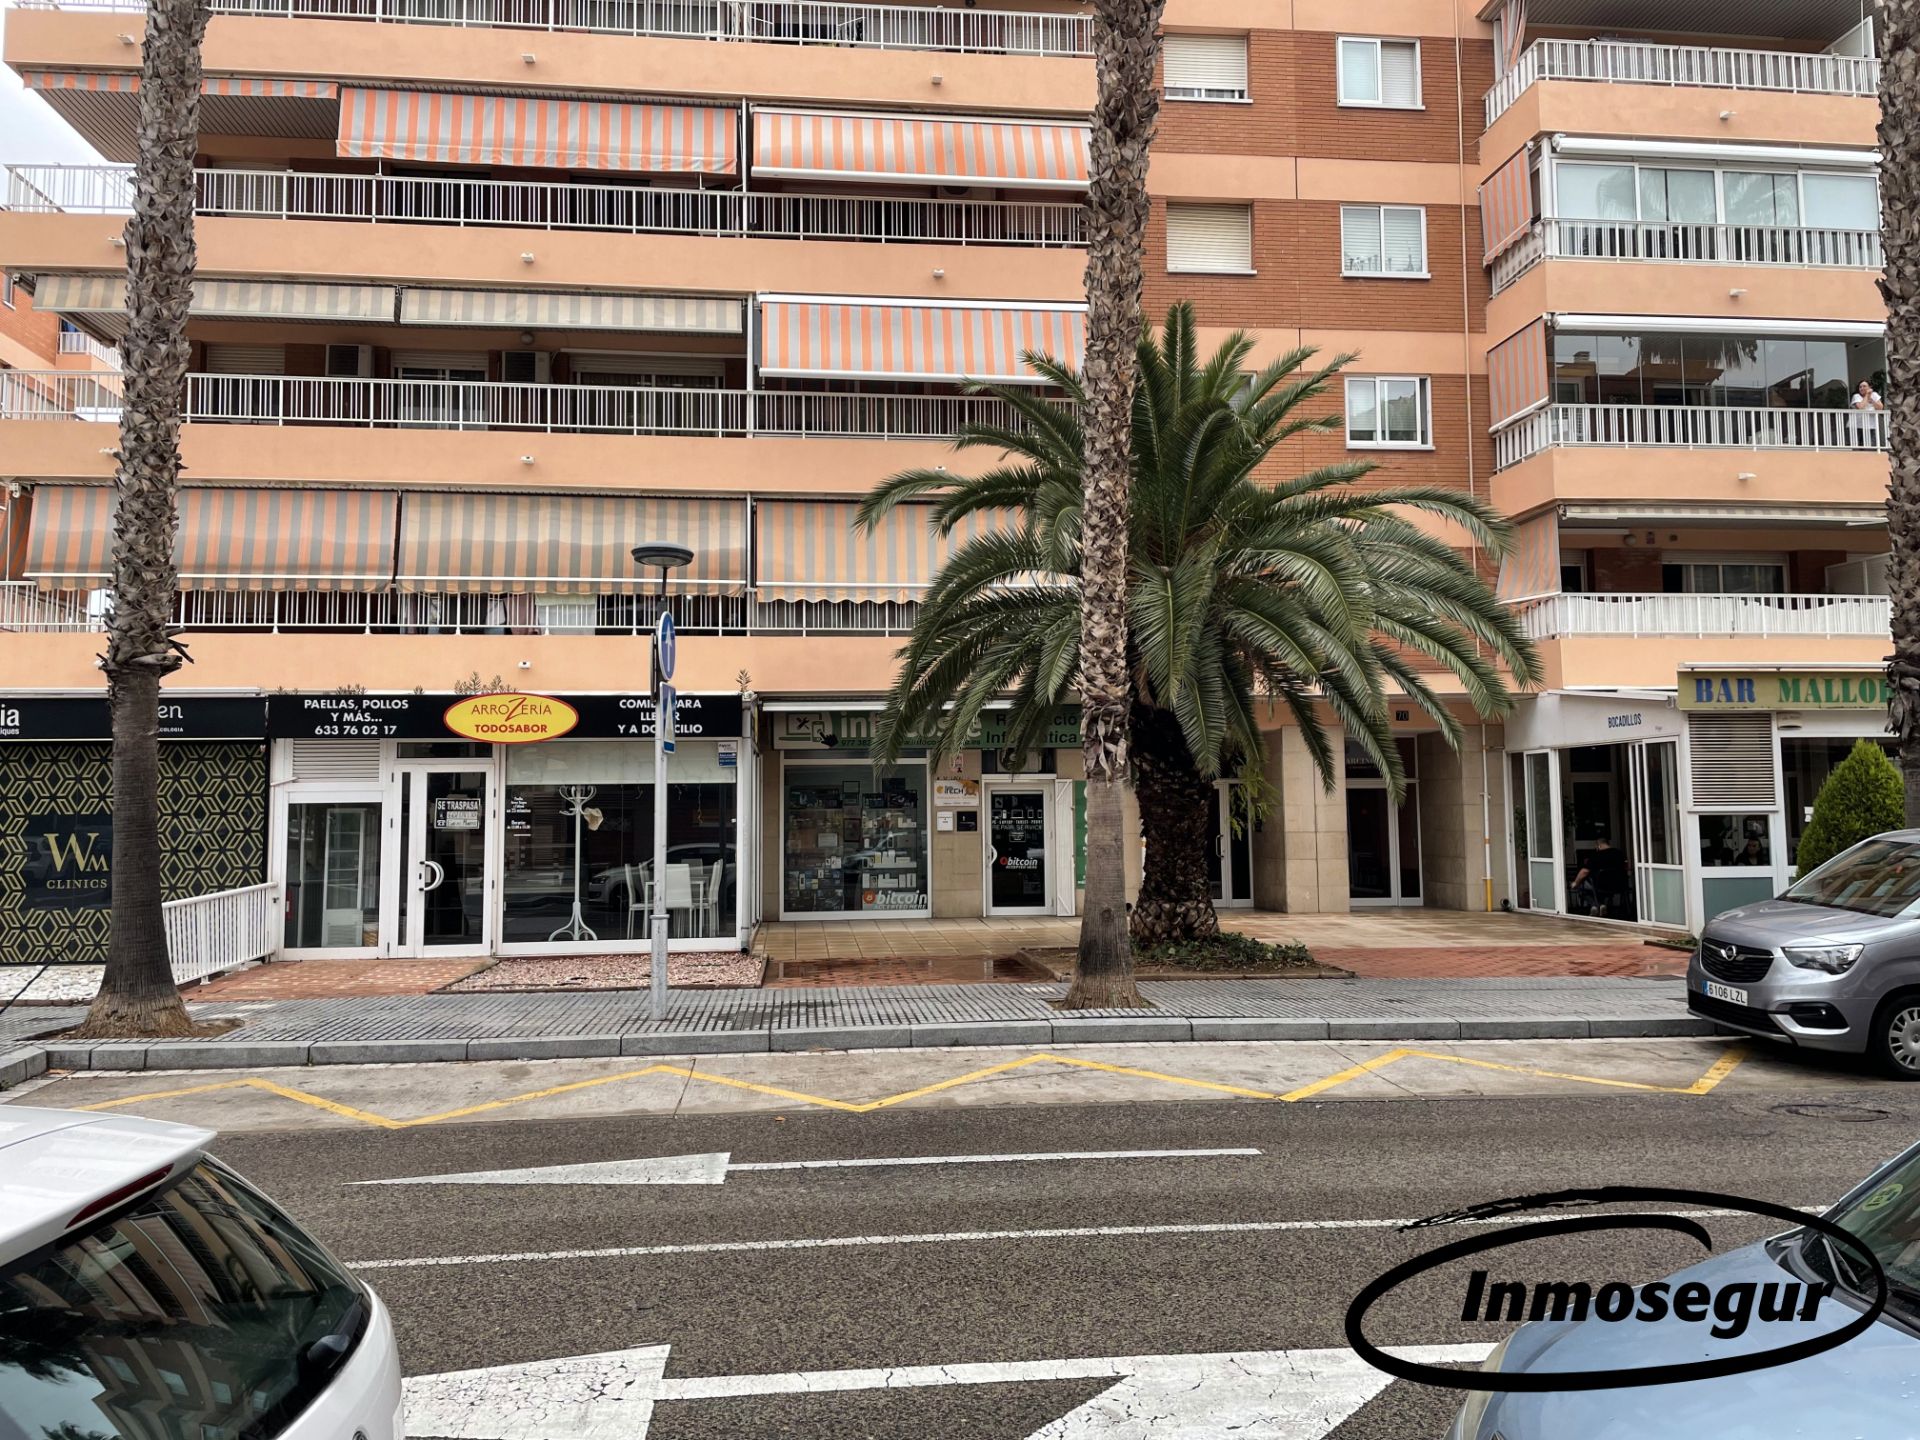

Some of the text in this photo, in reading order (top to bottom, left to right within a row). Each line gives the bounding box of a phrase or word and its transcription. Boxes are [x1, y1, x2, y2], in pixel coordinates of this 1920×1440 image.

[1694, 678, 1756, 703] BAR
[304, 699, 409, 710] PAELLAS, POLLOS
[331, 710, 383, 722] Y MÁS...
[640, 711, 680, 721] LLER
[1608, 713, 1642, 728] BOCADILLOS
[315, 725, 397, 735] 633 76 02 17
[475, 724, 548, 734] TODOSABOR
[617, 724, 703, 734] Y A DOCILIO
[437, 801, 479, 810] SE TRASPASA
[1007, 857, 1038, 866] bitcoin
[46, 879, 108, 889] CLINICS
[877, 889, 928, 905] bitcoin
[1708, 984, 1746, 1004] 6106 LZL
